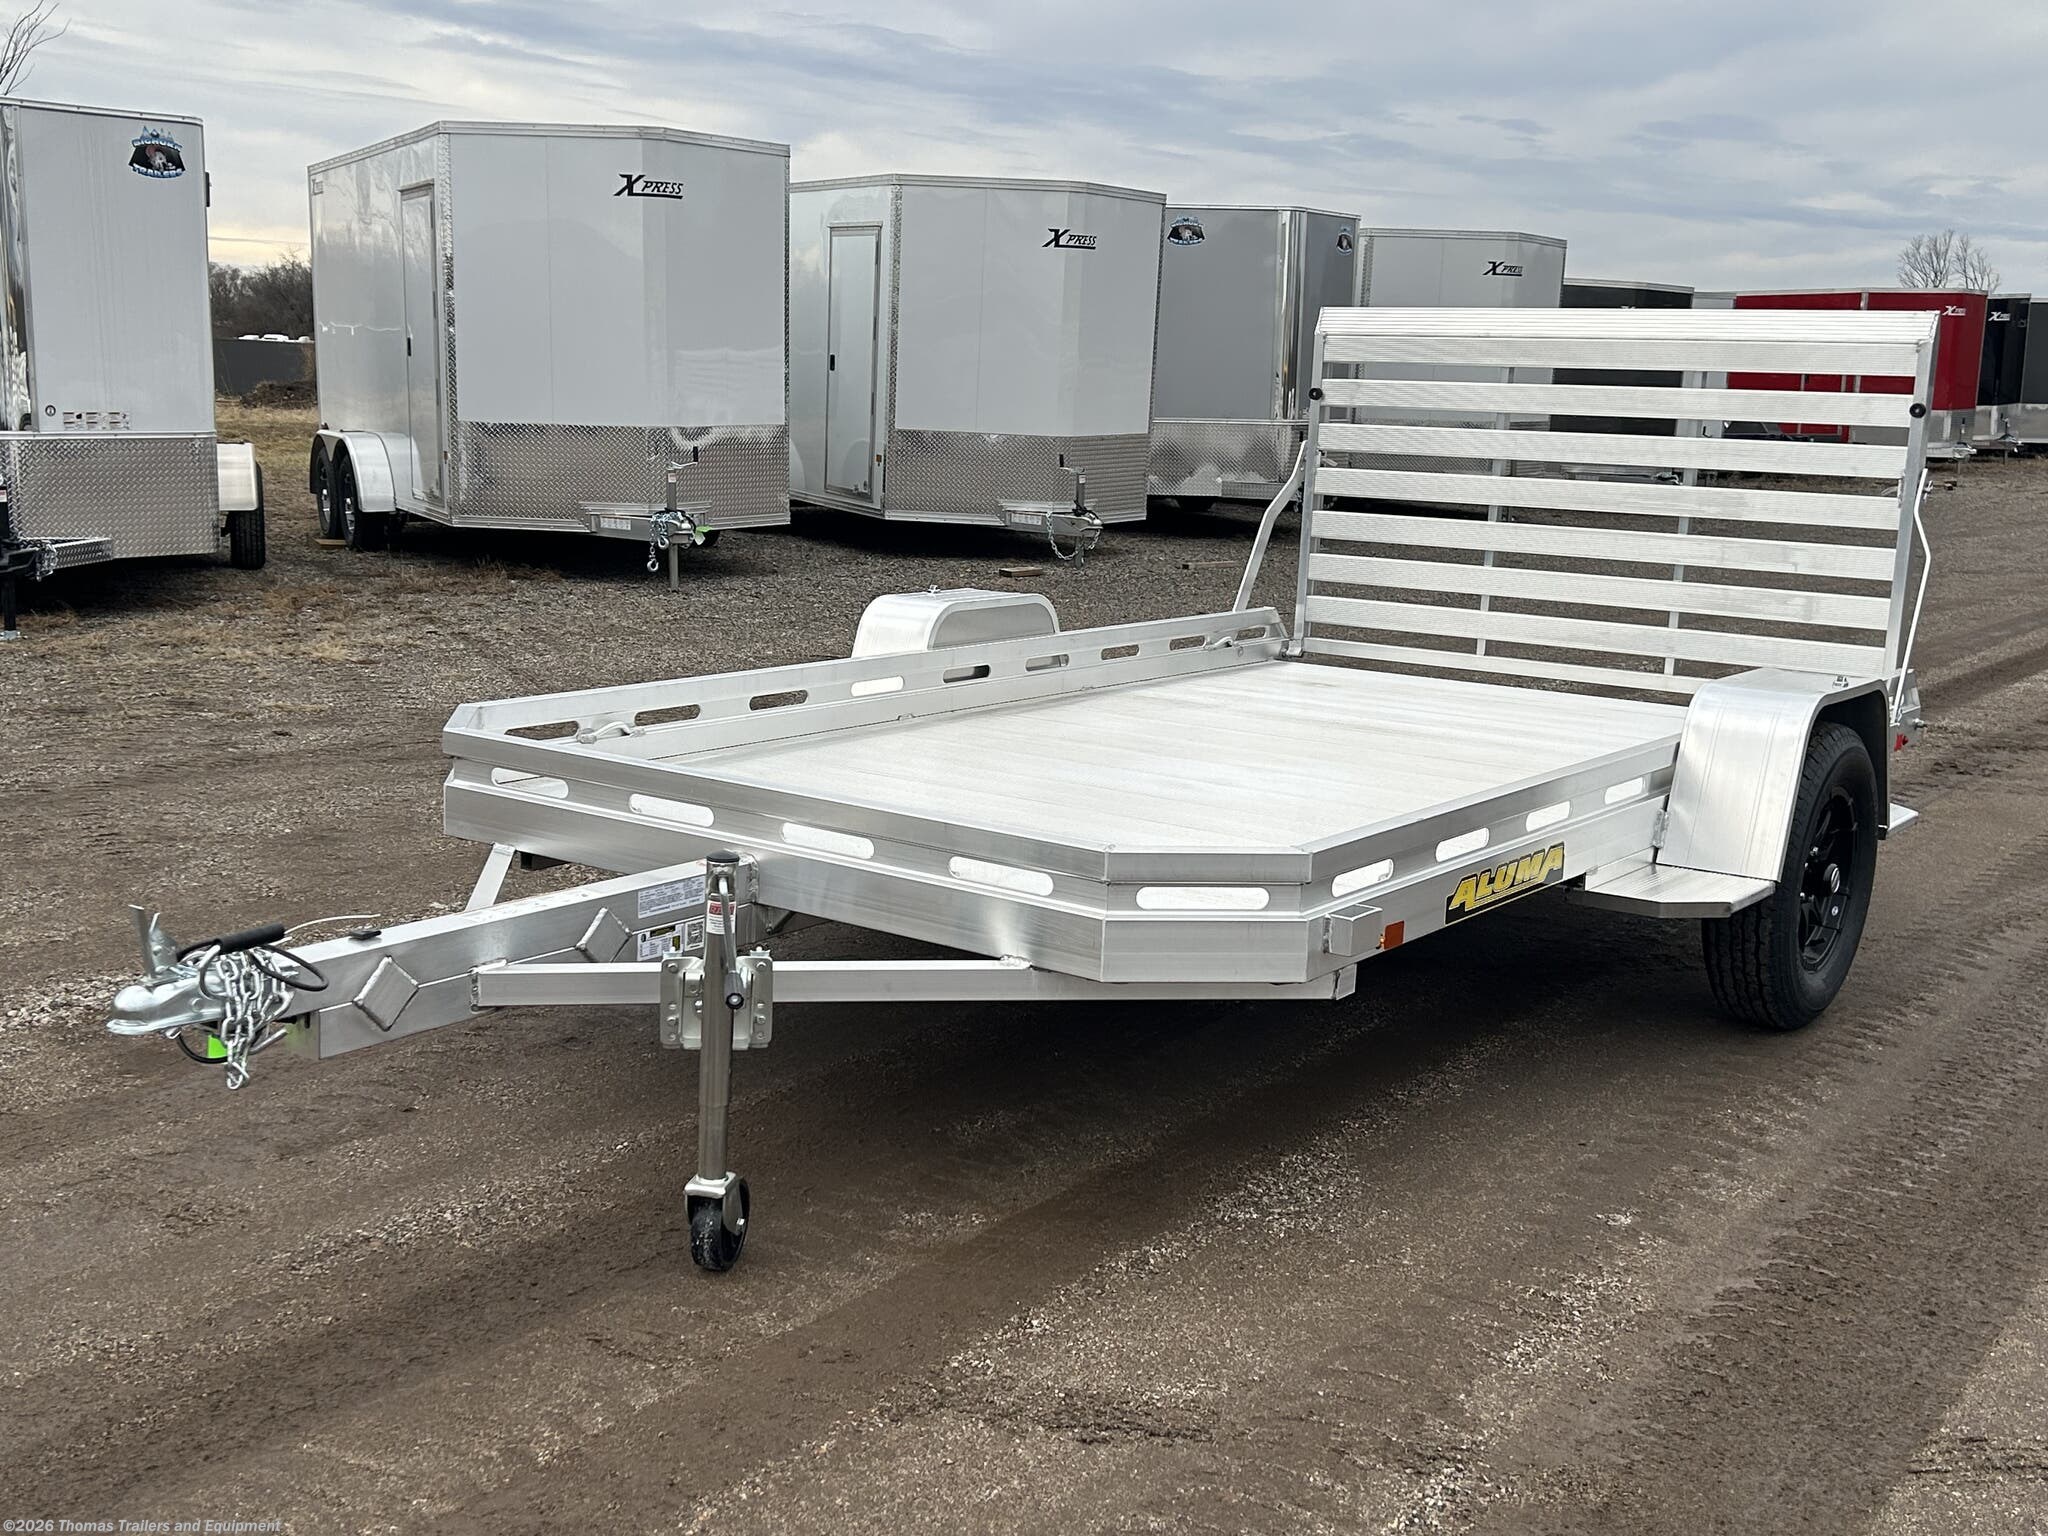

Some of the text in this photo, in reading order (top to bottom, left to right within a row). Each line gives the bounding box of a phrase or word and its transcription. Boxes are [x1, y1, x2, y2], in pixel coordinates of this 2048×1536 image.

[614, 174, 684, 199] XPRESS
[1042, 228, 1097, 250] XPRESS
[1448, 842, 1564, 912] ALUMA
